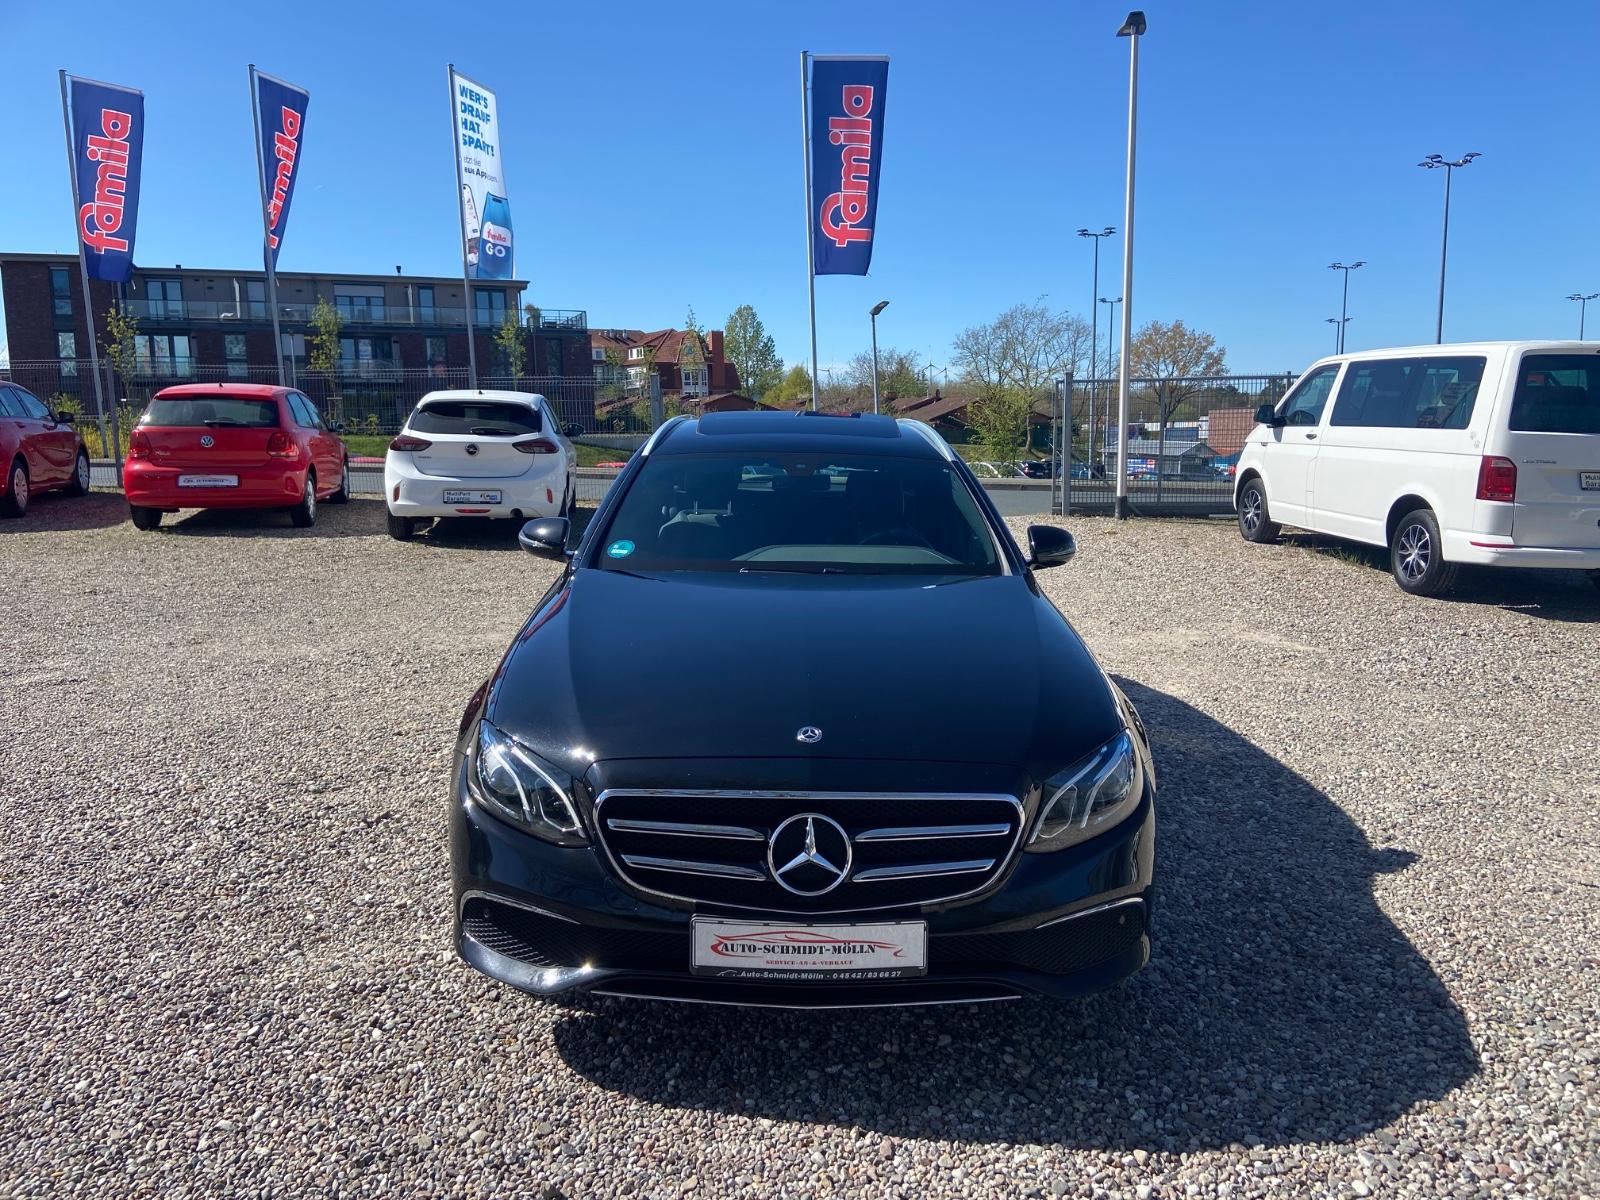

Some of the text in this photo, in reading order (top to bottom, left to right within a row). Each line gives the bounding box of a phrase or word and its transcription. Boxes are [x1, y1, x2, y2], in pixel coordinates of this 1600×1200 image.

[459, 84, 488, 109] WER'S
[820, 85, 874, 247] famila
[80, 108, 132, 254] famila
[485, 242, 506, 258] GO
[720, 942, 876, 955] AUTO-SCHMIDT-MÖLLN
[740, 970, 824, 979] Auto-Schmidt-Mölln
